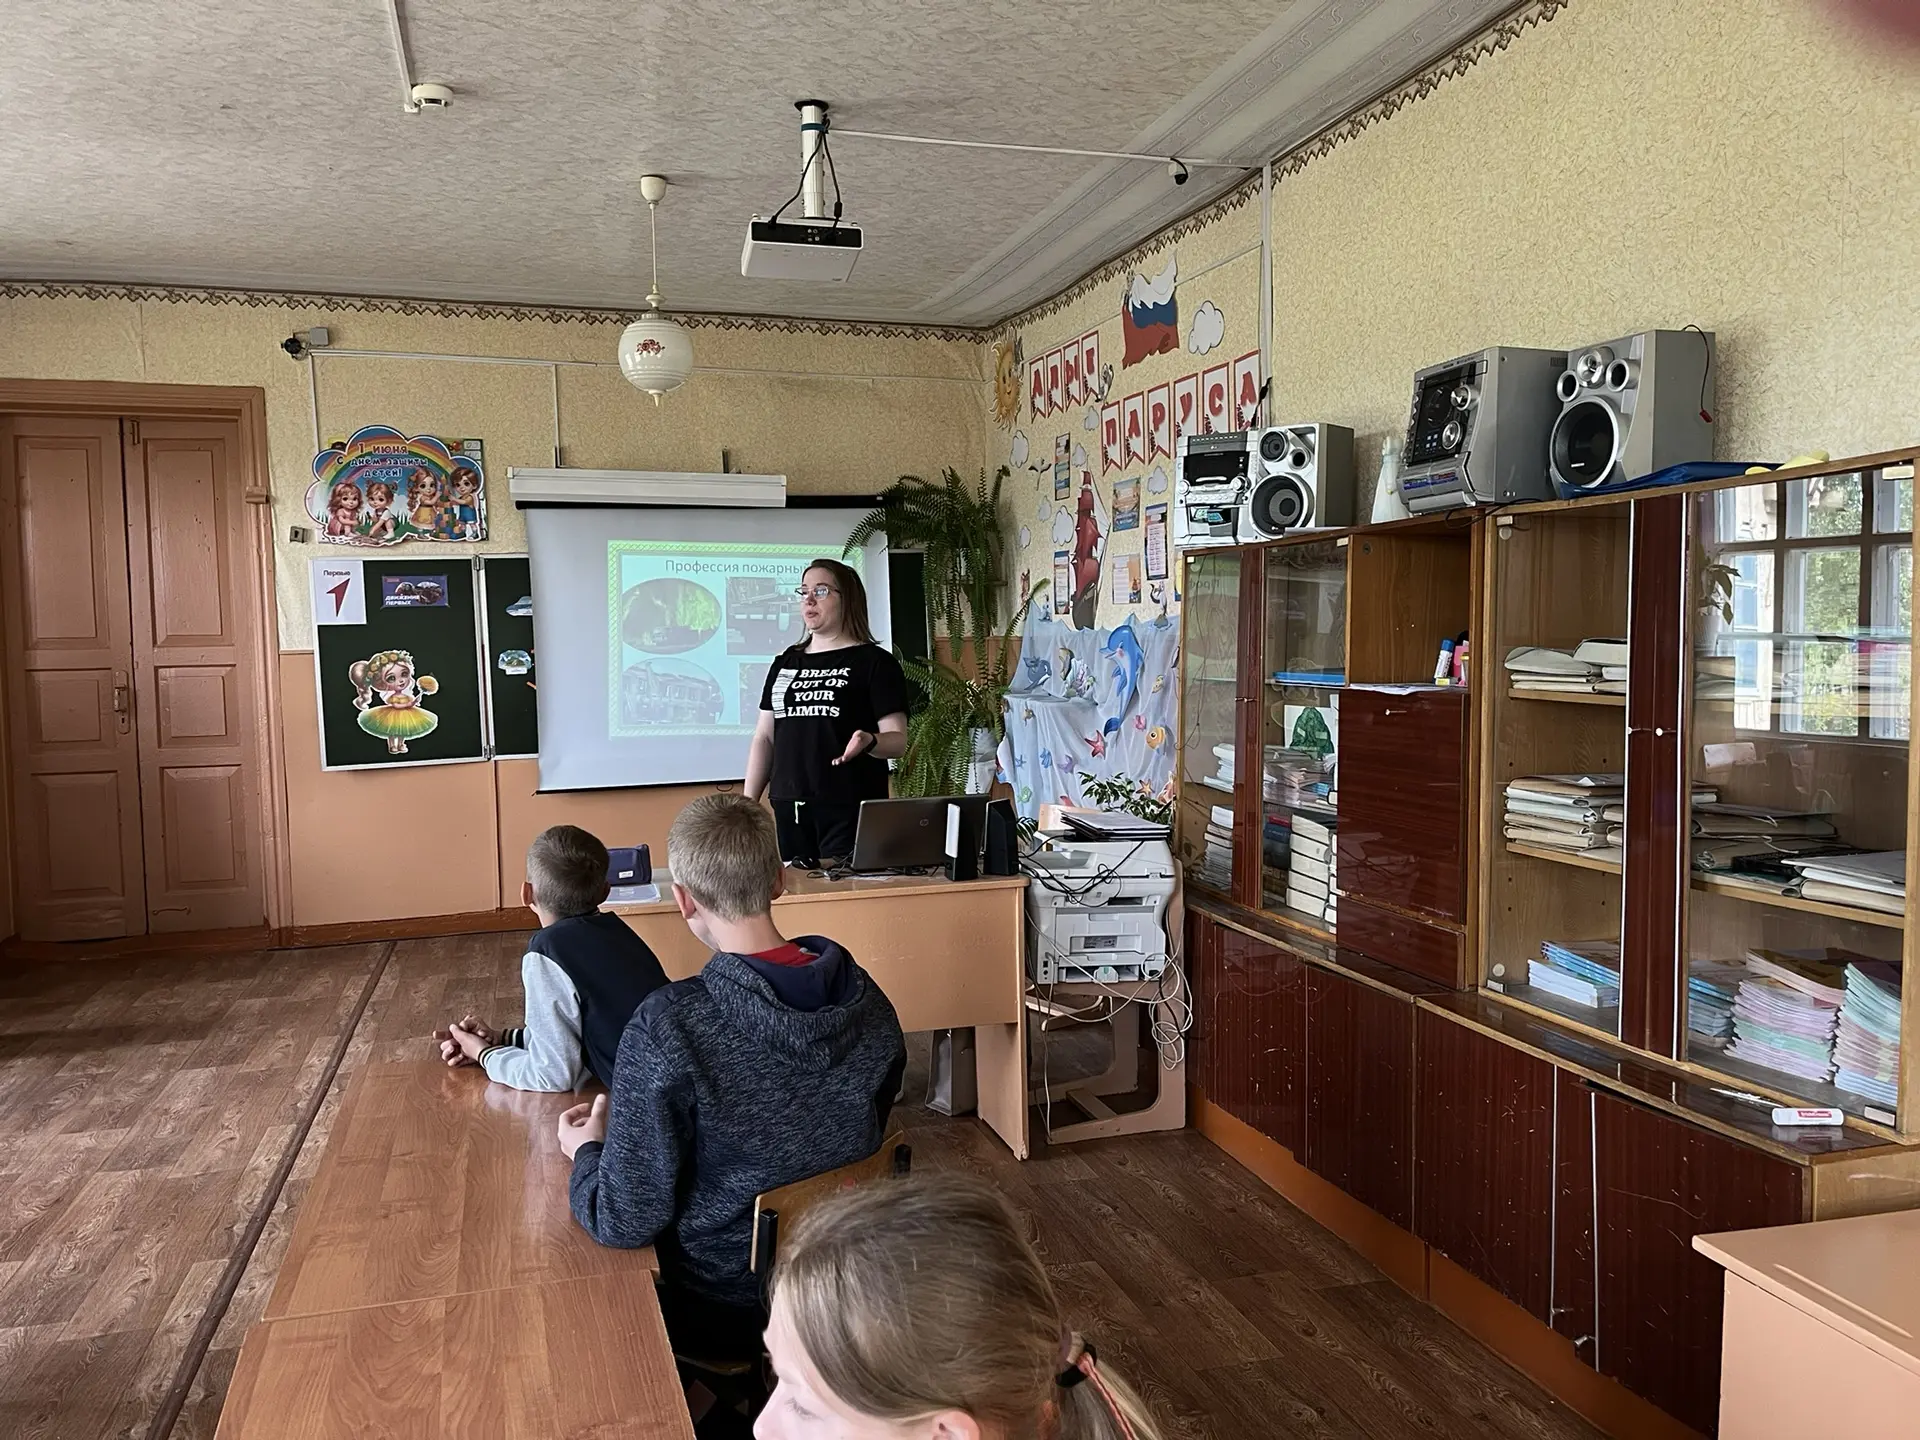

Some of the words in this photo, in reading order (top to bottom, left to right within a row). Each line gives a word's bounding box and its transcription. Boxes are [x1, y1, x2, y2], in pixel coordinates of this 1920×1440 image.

[1105, 371, 1257, 447] ПАРУСА
[358, 443, 365, 454] 1
[372, 445, 408, 454] июня
[387, 458, 427, 466] защиты
[665, 560, 739, 574] Профессия
[799, 667, 851, 678] BREAK
[791, 680, 822, 689] OUT
[825, 678, 848, 688] OF
[794, 690, 835, 702] YOUR
[787, 705, 840, 717] LIMITS
